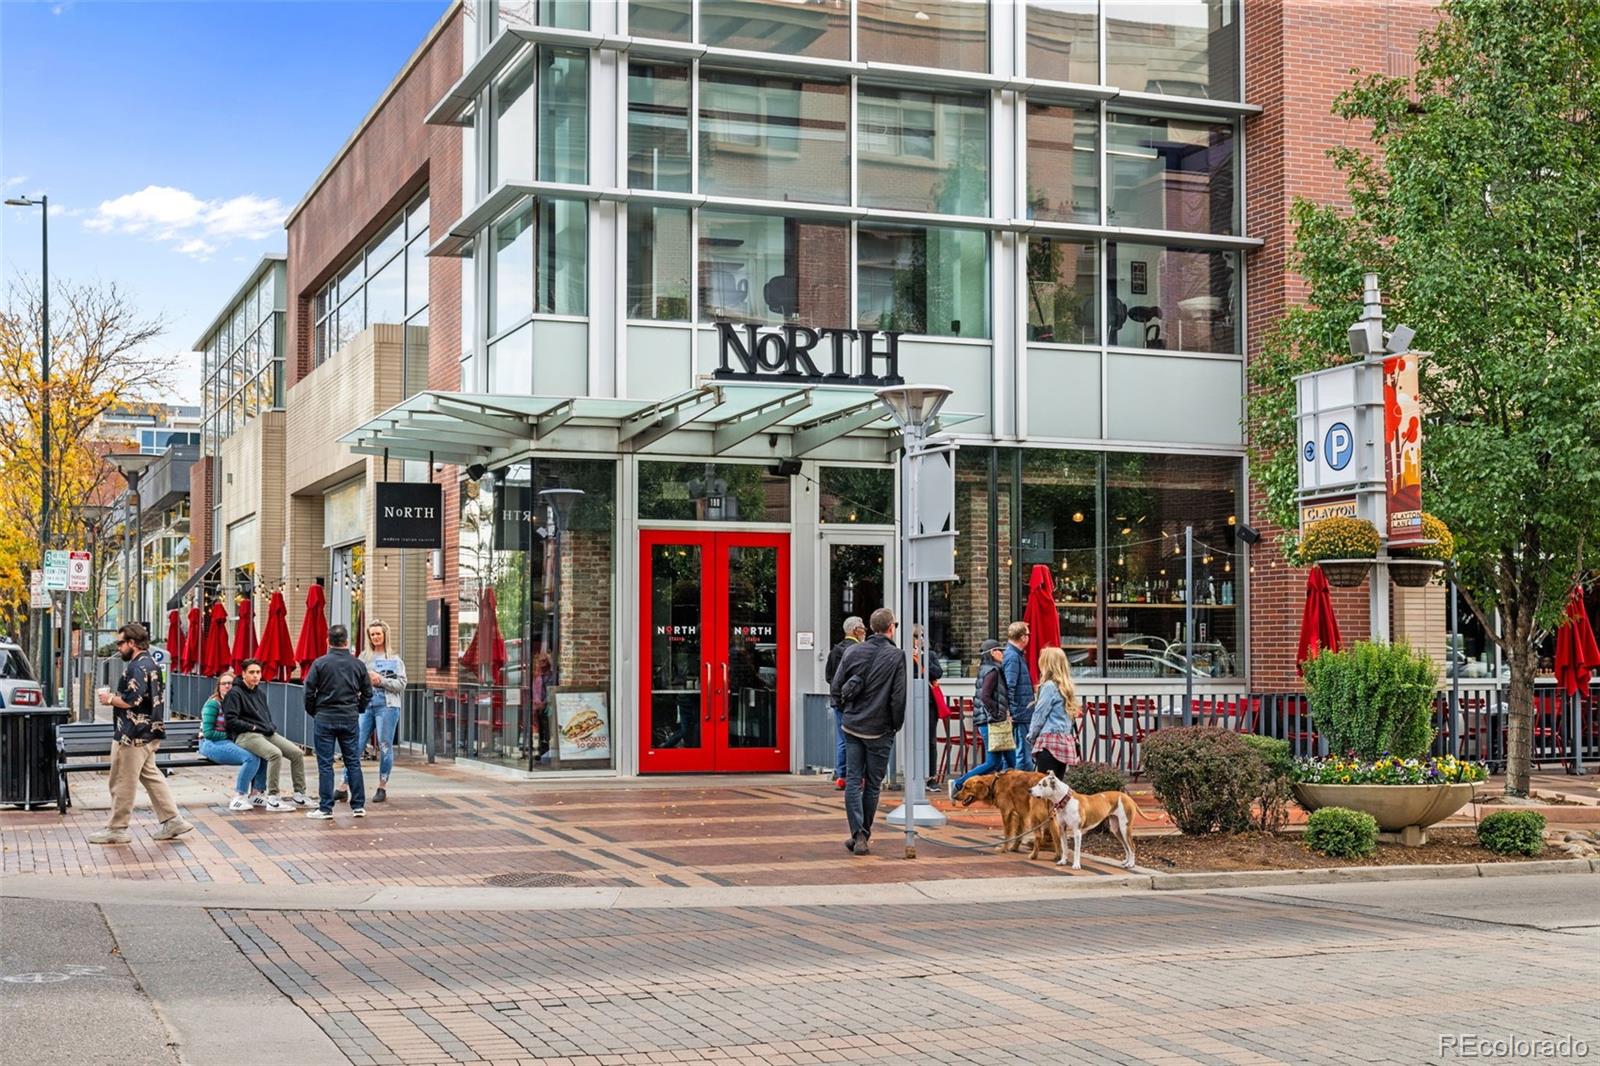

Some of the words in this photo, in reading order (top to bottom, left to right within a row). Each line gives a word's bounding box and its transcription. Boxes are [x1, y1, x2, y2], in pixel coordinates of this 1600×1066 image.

[1332, 429, 1349, 465] P
[1307, 505, 1356, 520] CLAYTON
[657, 625, 696, 635] NORTH
[733, 626, 772, 635] NORTH
